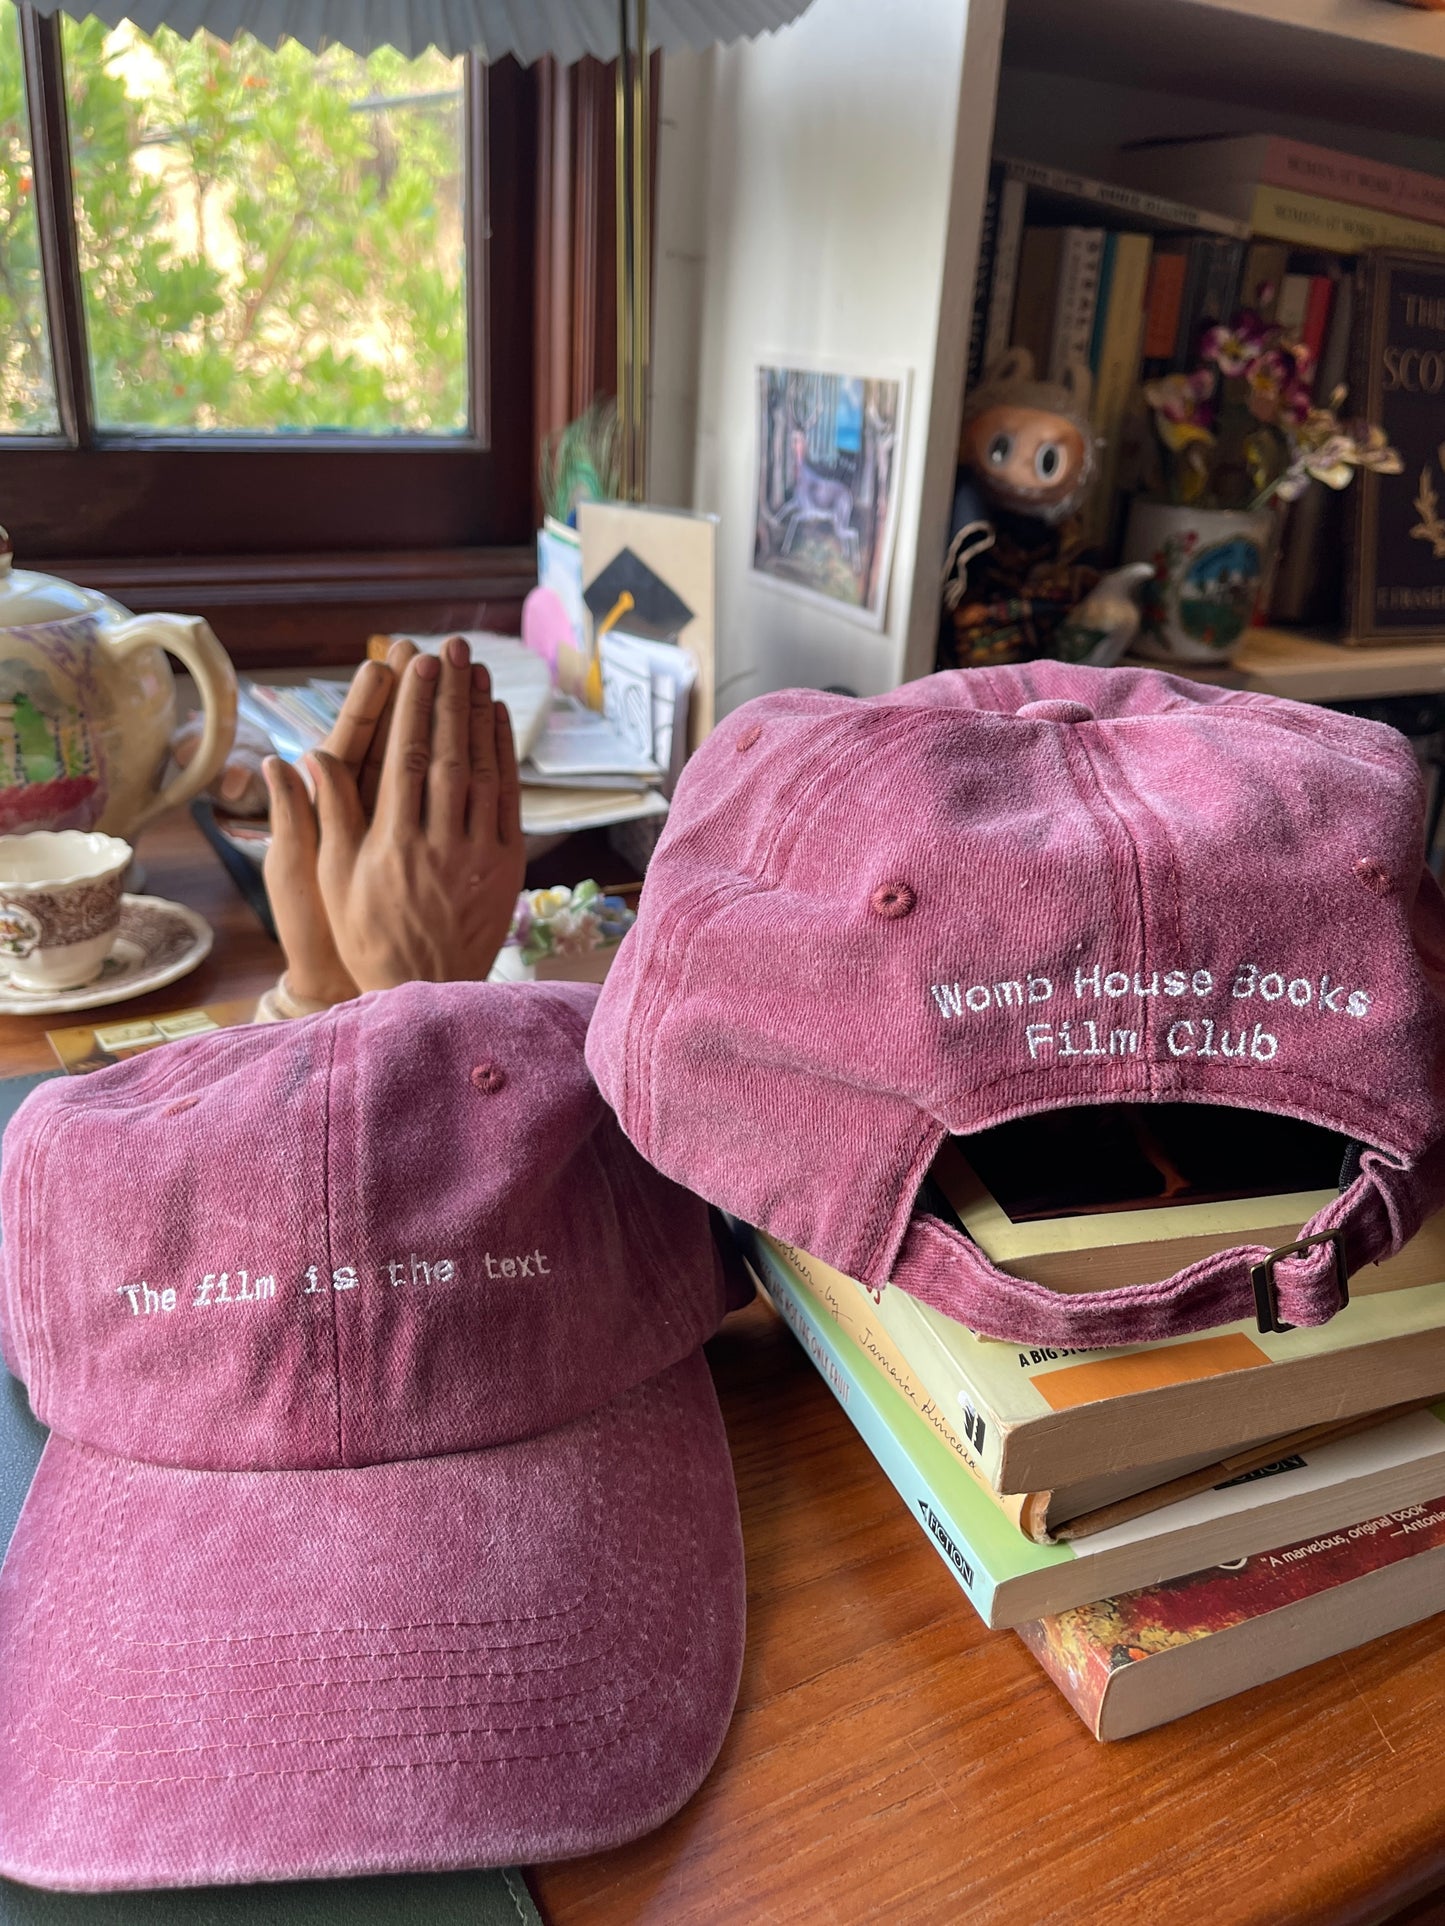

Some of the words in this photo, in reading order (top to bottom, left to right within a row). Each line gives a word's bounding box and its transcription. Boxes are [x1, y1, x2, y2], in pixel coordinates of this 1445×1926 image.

[1383, 346, 1445, 393] SCO
[931, 973, 1053, 1019] Womb
[1074, 963, 1213, 999] House
[1232, 963, 1372, 1017] Books
[1026, 1020, 1138, 1059] Film
[1166, 1018, 1279, 1061] Club
[117, 1280, 176, 1315] The
[193, 1270, 275, 1307] film
[304, 1265, 359, 1294] is
[381, 1252, 455, 1287] the
[482, 1249, 551, 1279] text
[1018, 1353, 1031, 1368] A
[1029, 1347, 1059, 1365] BIG
[829, 1362, 850, 1405] FRUIT
[929, 1512, 973, 1586] FICTION
[1282, 1532, 1351, 1564] marvelous,
[1347, 1514, 1394, 1539] original
[1389, 1503, 1428, 1522] book
